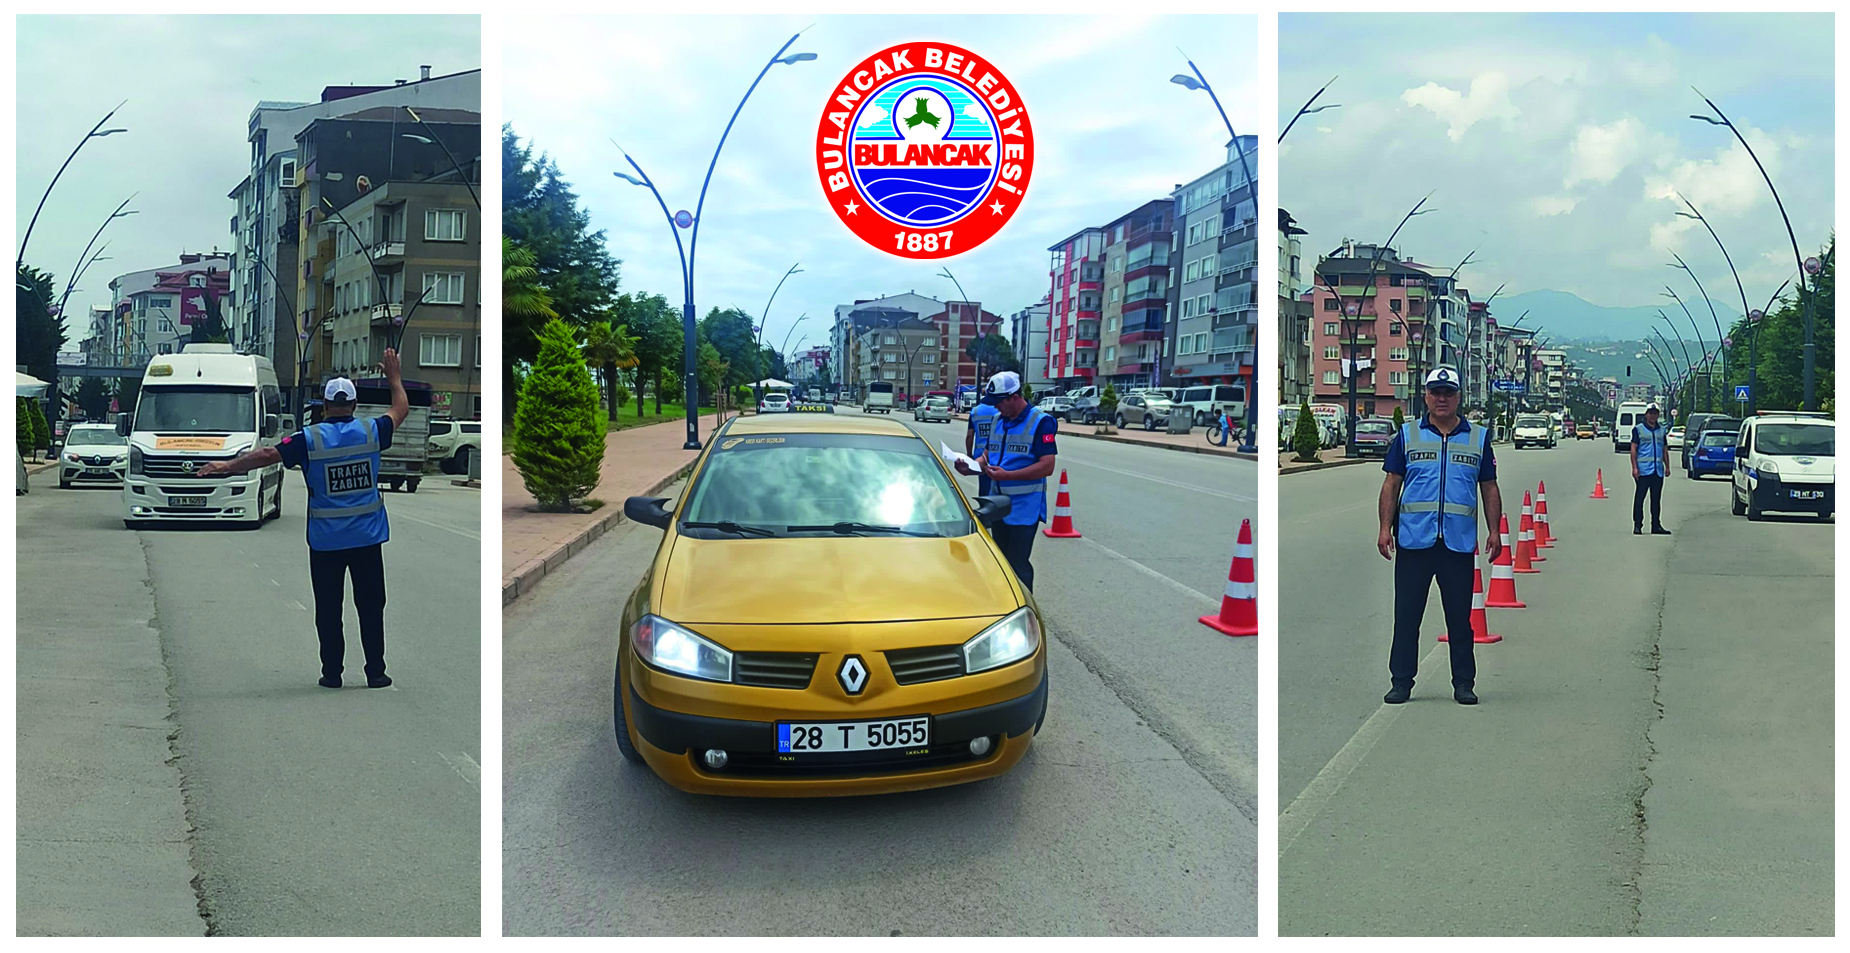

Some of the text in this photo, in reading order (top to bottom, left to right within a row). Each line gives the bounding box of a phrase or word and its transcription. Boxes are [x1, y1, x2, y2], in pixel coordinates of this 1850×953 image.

[331, 475, 370, 491] ZABITA
[792, 726, 823, 750] 28
[838, 725, 855, 749] T
[867, 719, 927, 747] 5055
